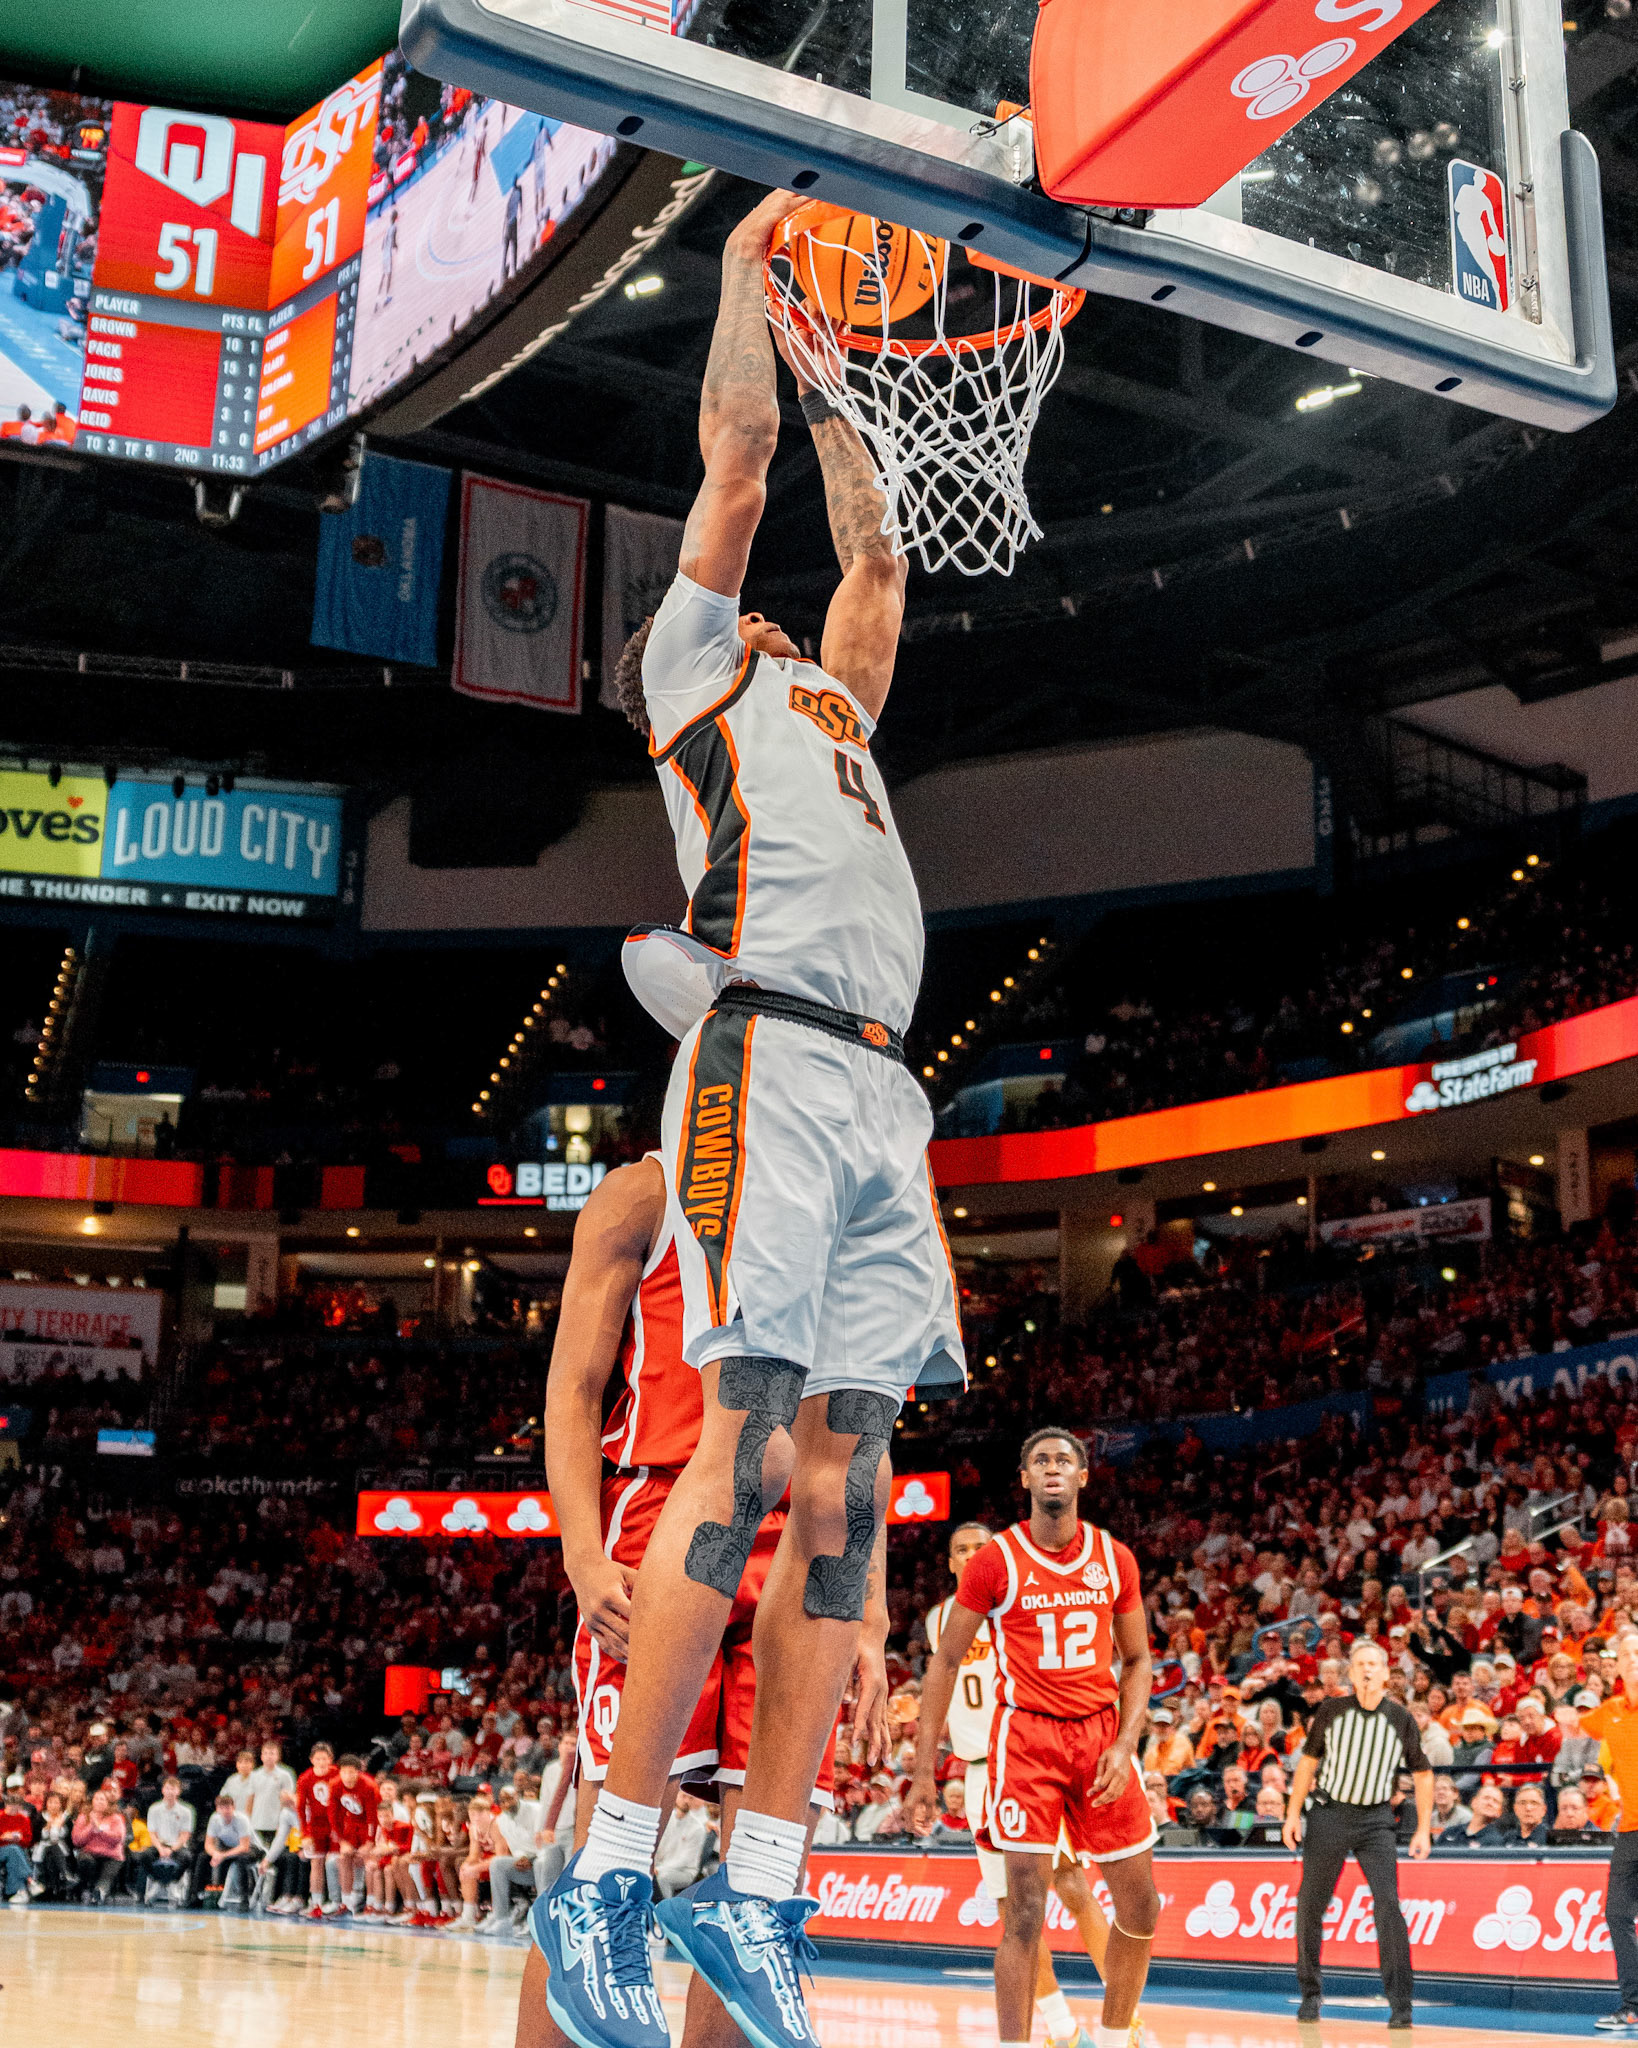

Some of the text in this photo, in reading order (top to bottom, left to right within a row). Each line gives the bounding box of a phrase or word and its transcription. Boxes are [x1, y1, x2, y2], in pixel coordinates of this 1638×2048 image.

[302, 196, 340, 281] 51
[154, 222, 218, 296] 51
[854, 219, 894, 306] Wilso
[1462, 271, 1491, 302] NBA
[90, 316, 137, 338] BROWN
[95, 294, 264, 332] PLAYER PTS FL
[87, 339, 122, 359] PACK
[84, 362, 124, 383] JONES
[82, 385, 120, 407] DAVIS
[80, 409, 112, 429] REID
[174, 447, 202, 465] 2ND
[834, 748, 886, 836] 4
[0, 799, 331, 880] ves LOUD CITY
[29, 880, 150, 906] THUNDER
[185, 891, 241, 912] EXIT
[247, 896, 305, 918] NOW
[685, 1082, 734, 1240] COWBOYS
[32, 1310, 132, 1338] TERRACE
[1020, 1590, 1109, 1610] OKLAHOMA
[1035, 1611, 1098, 1669] 12
[963, 1673, 983, 1709] 0
